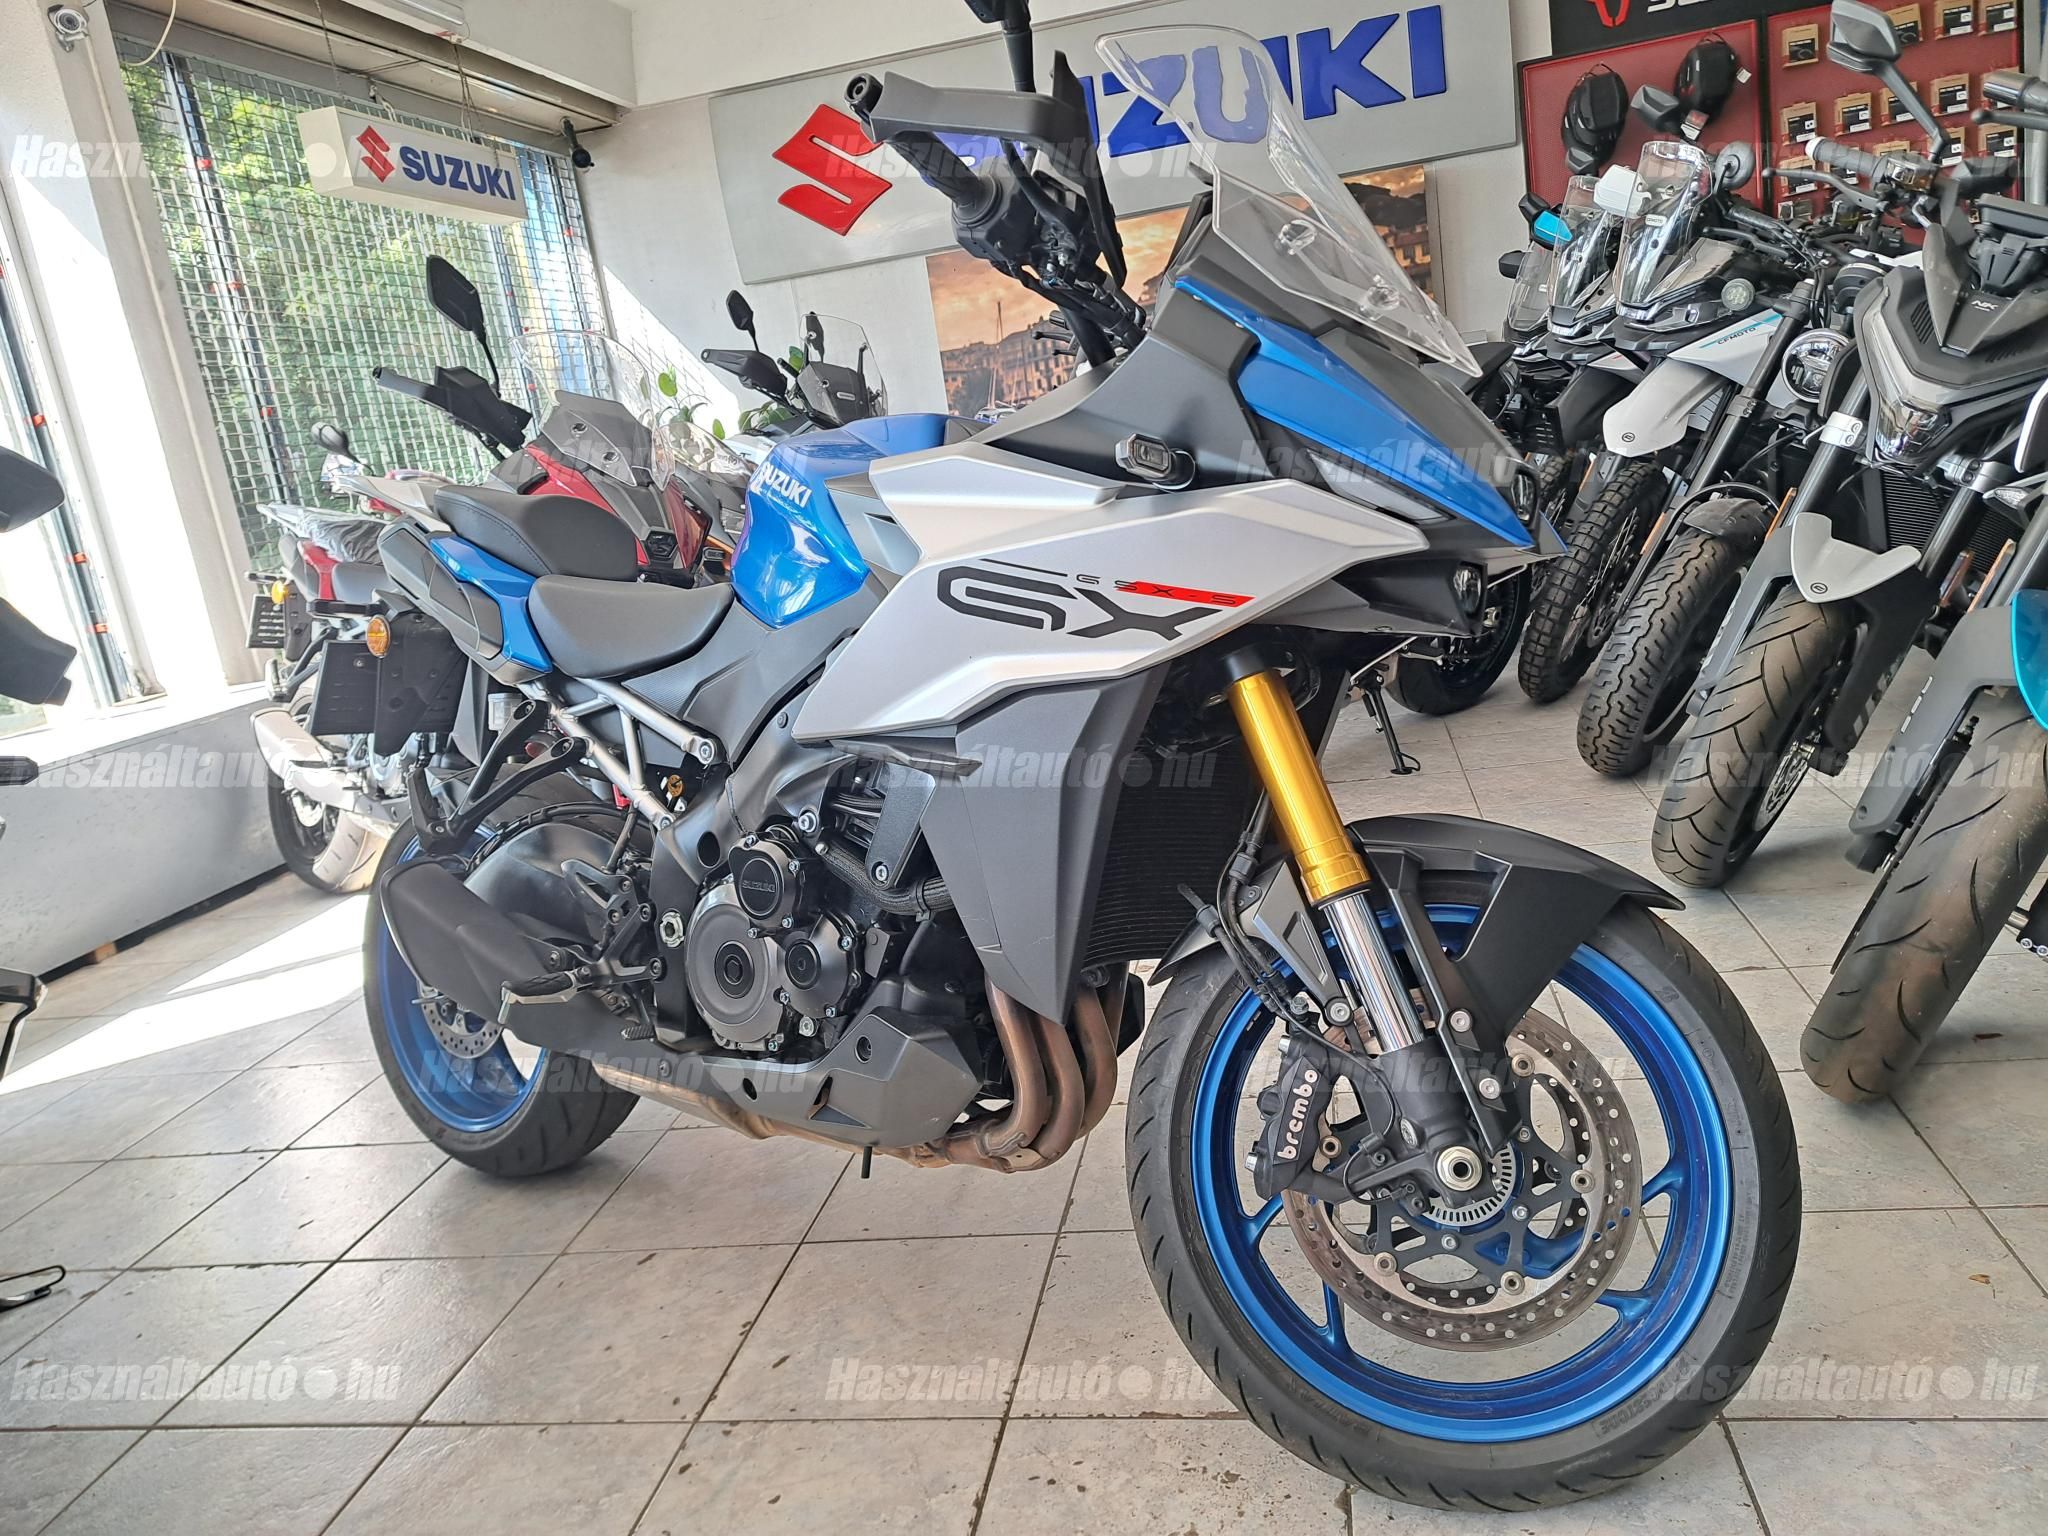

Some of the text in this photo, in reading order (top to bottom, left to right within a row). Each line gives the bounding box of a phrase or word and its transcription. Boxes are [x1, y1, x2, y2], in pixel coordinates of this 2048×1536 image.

[400, 146, 516, 200] SUZUKI
[1717, 327, 1756, 345] CFMOTO
[1277, 1069, 1318, 1160] brembo
